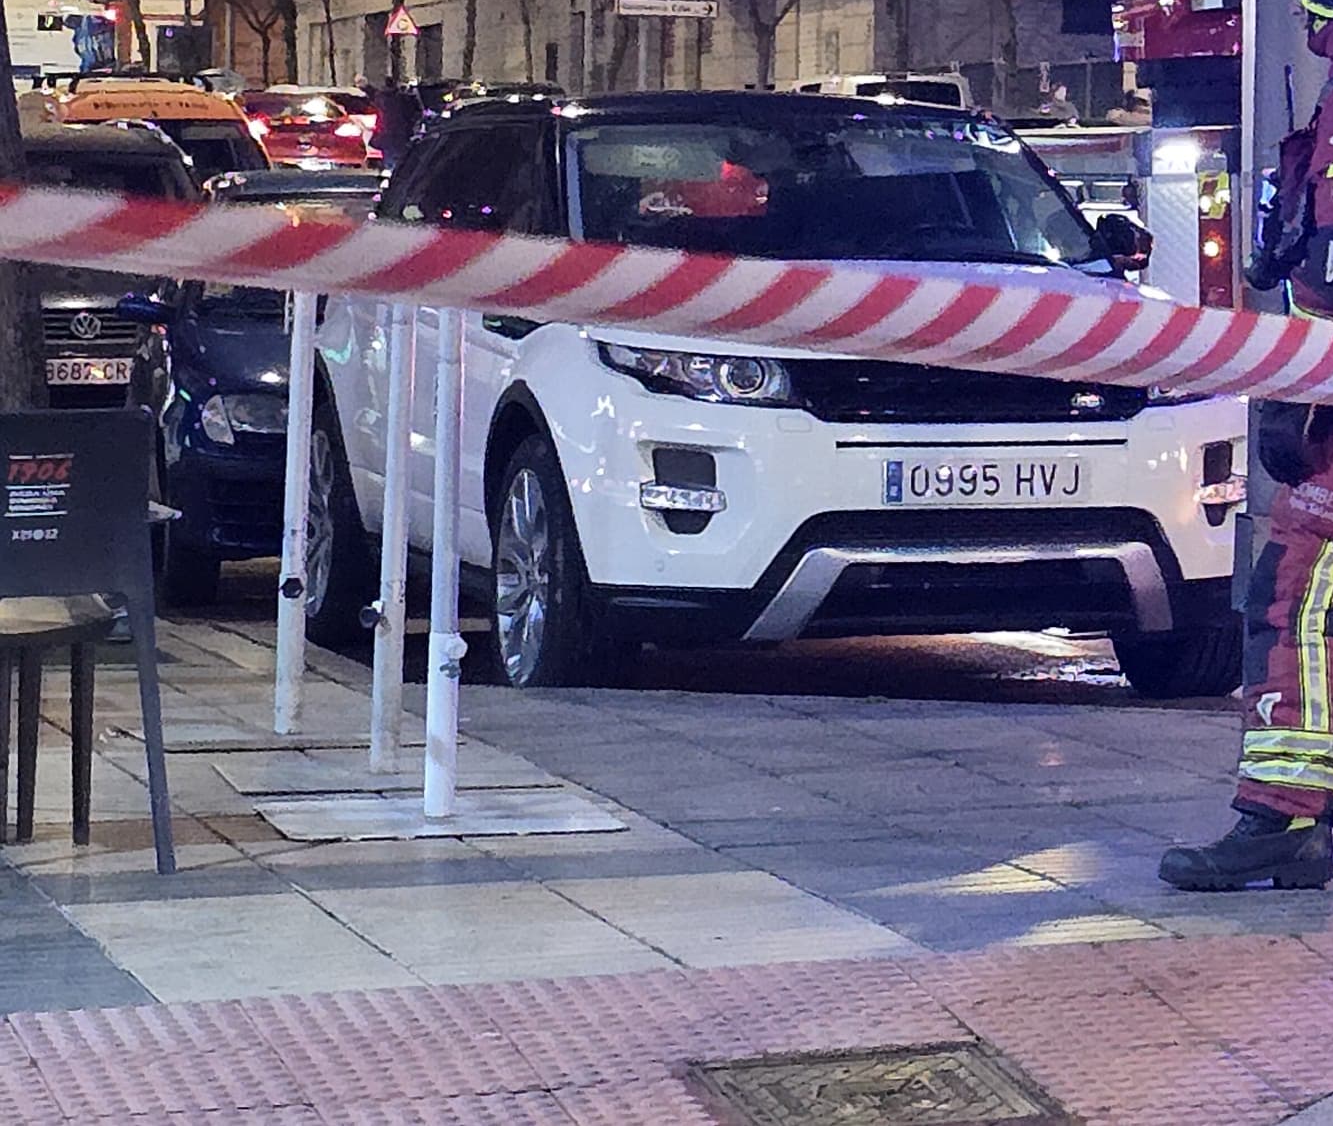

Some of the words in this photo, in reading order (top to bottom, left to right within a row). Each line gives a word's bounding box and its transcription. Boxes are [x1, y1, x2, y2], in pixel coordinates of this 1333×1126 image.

[8, 461, 73, 482] 1906
[910, 463, 1001, 496] 0995
[1016, 463, 1080, 496] HVJ
